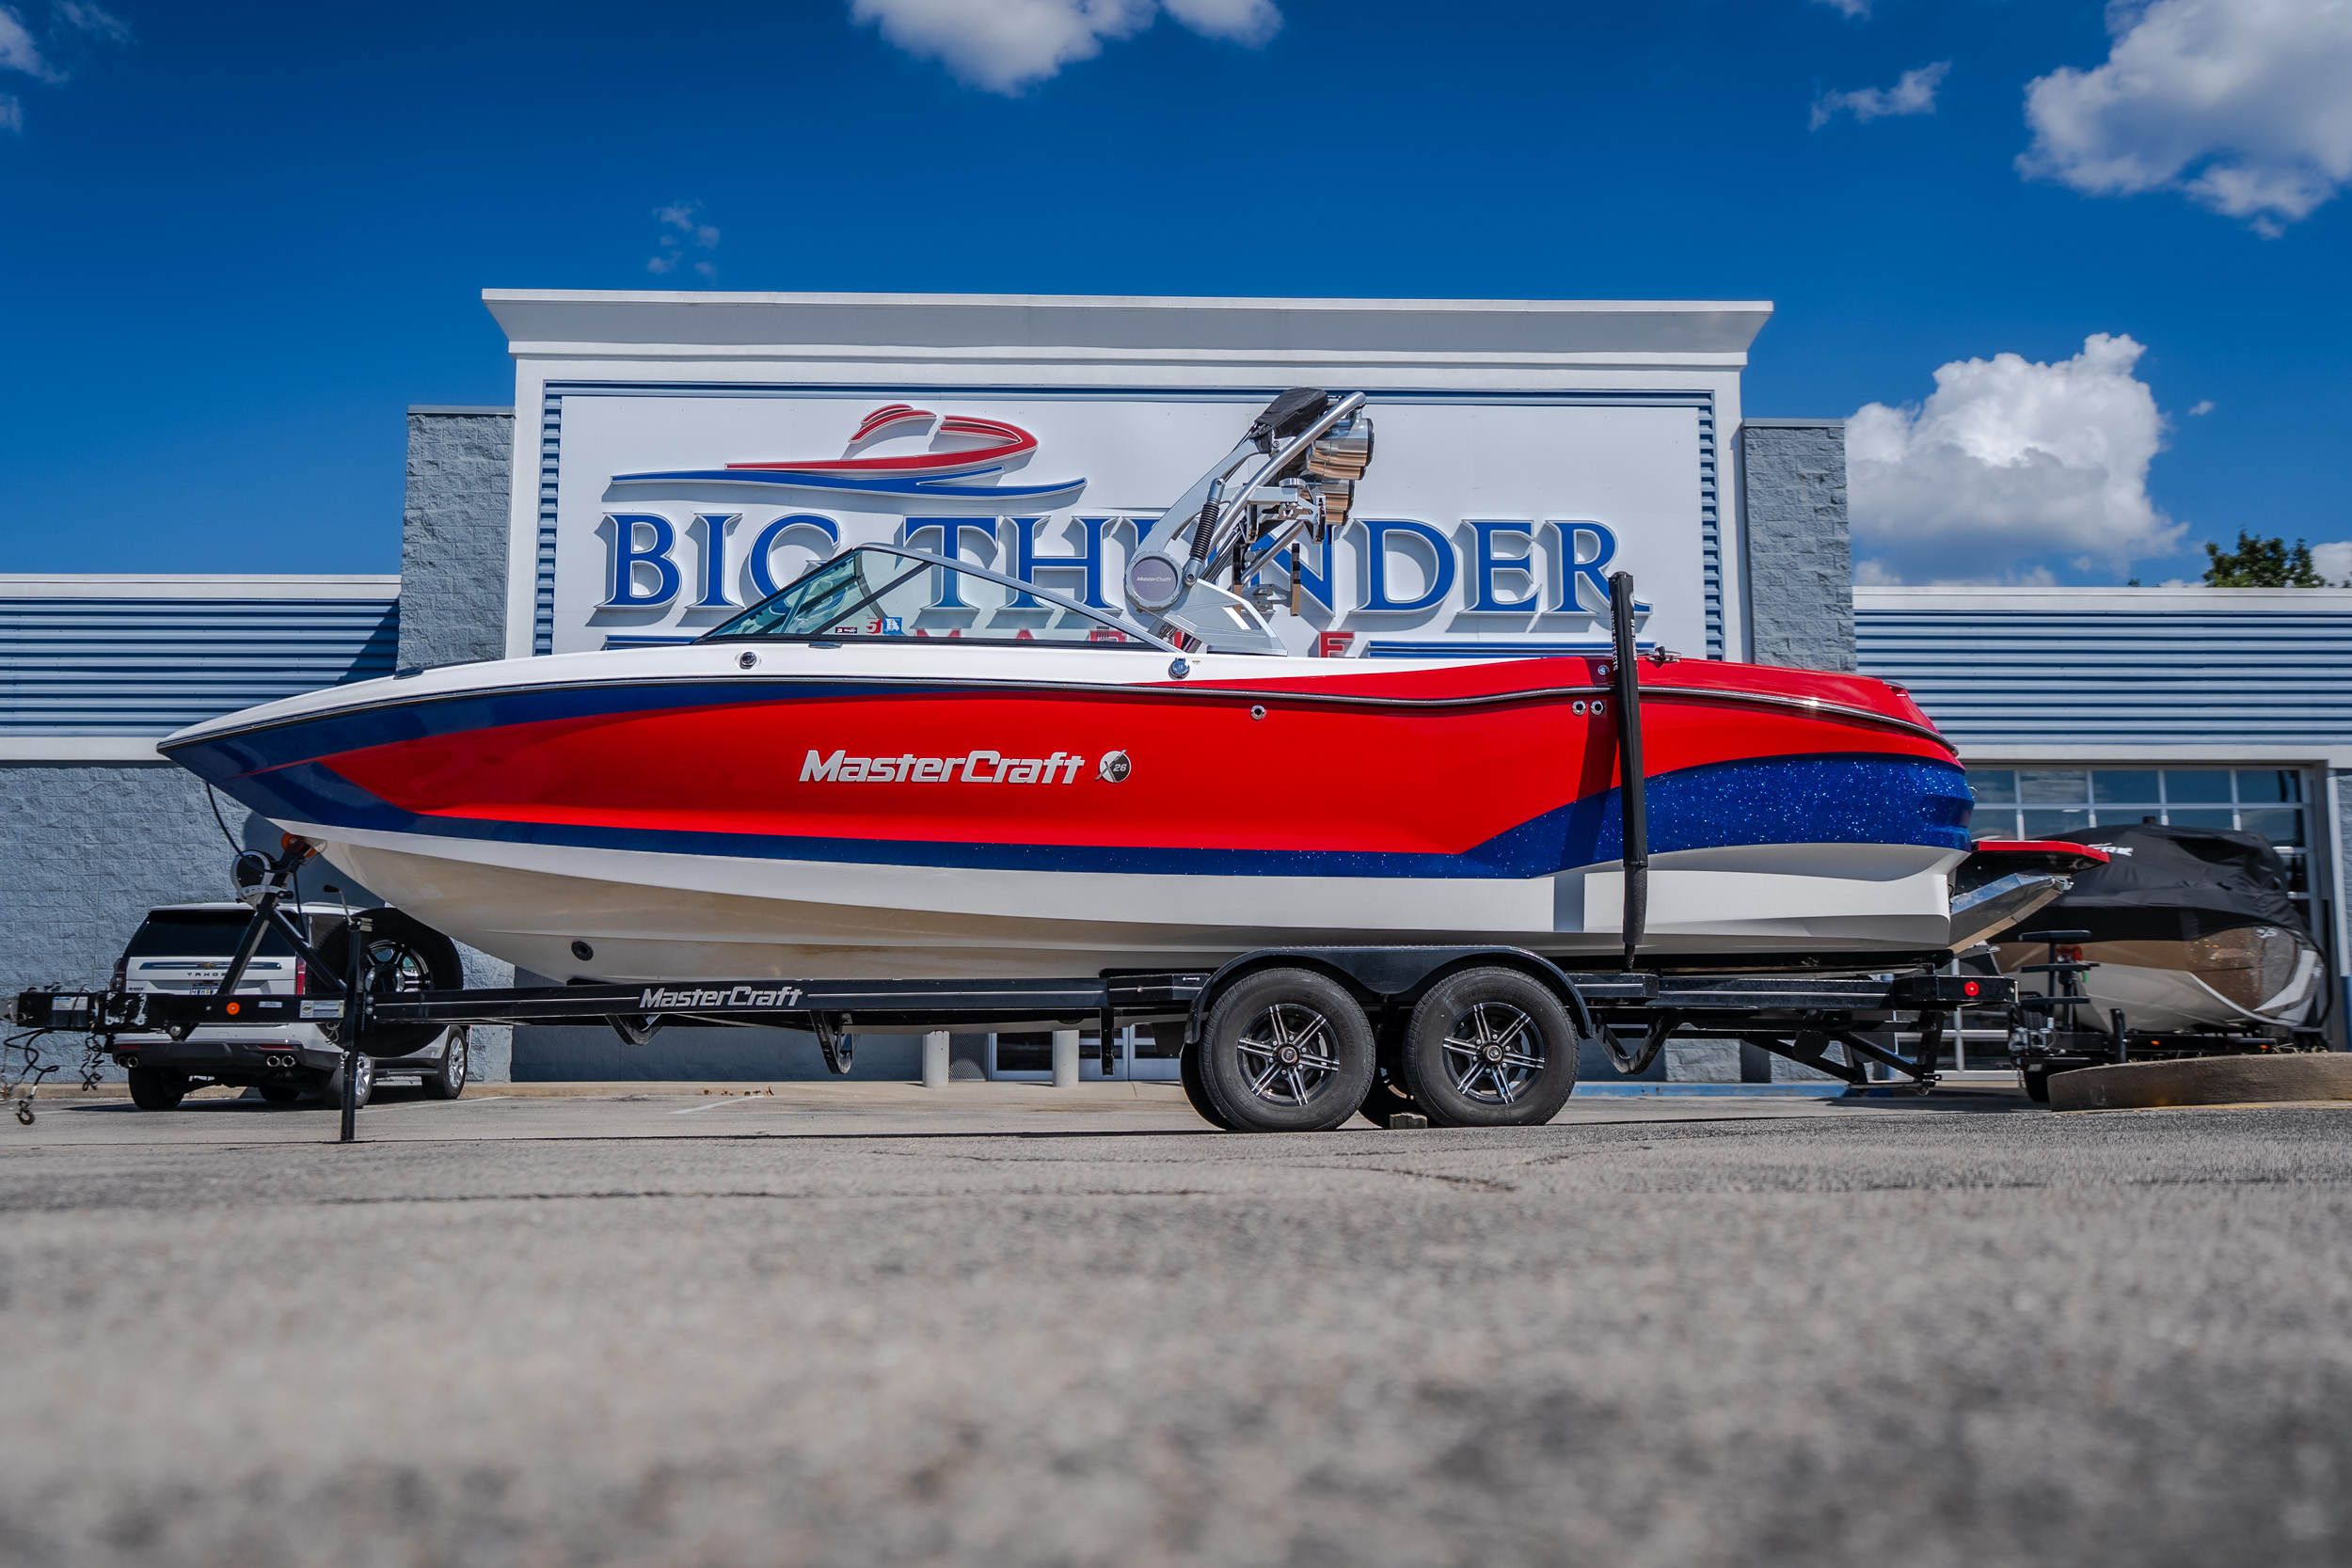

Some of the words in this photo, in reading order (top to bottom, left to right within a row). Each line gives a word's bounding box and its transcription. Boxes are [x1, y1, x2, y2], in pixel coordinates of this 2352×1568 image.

[596, 512, 844, 615] BIG
[799, 750, 1085, 784] MasterCraft
[640, 986, 803, 1008] MasterCraft
